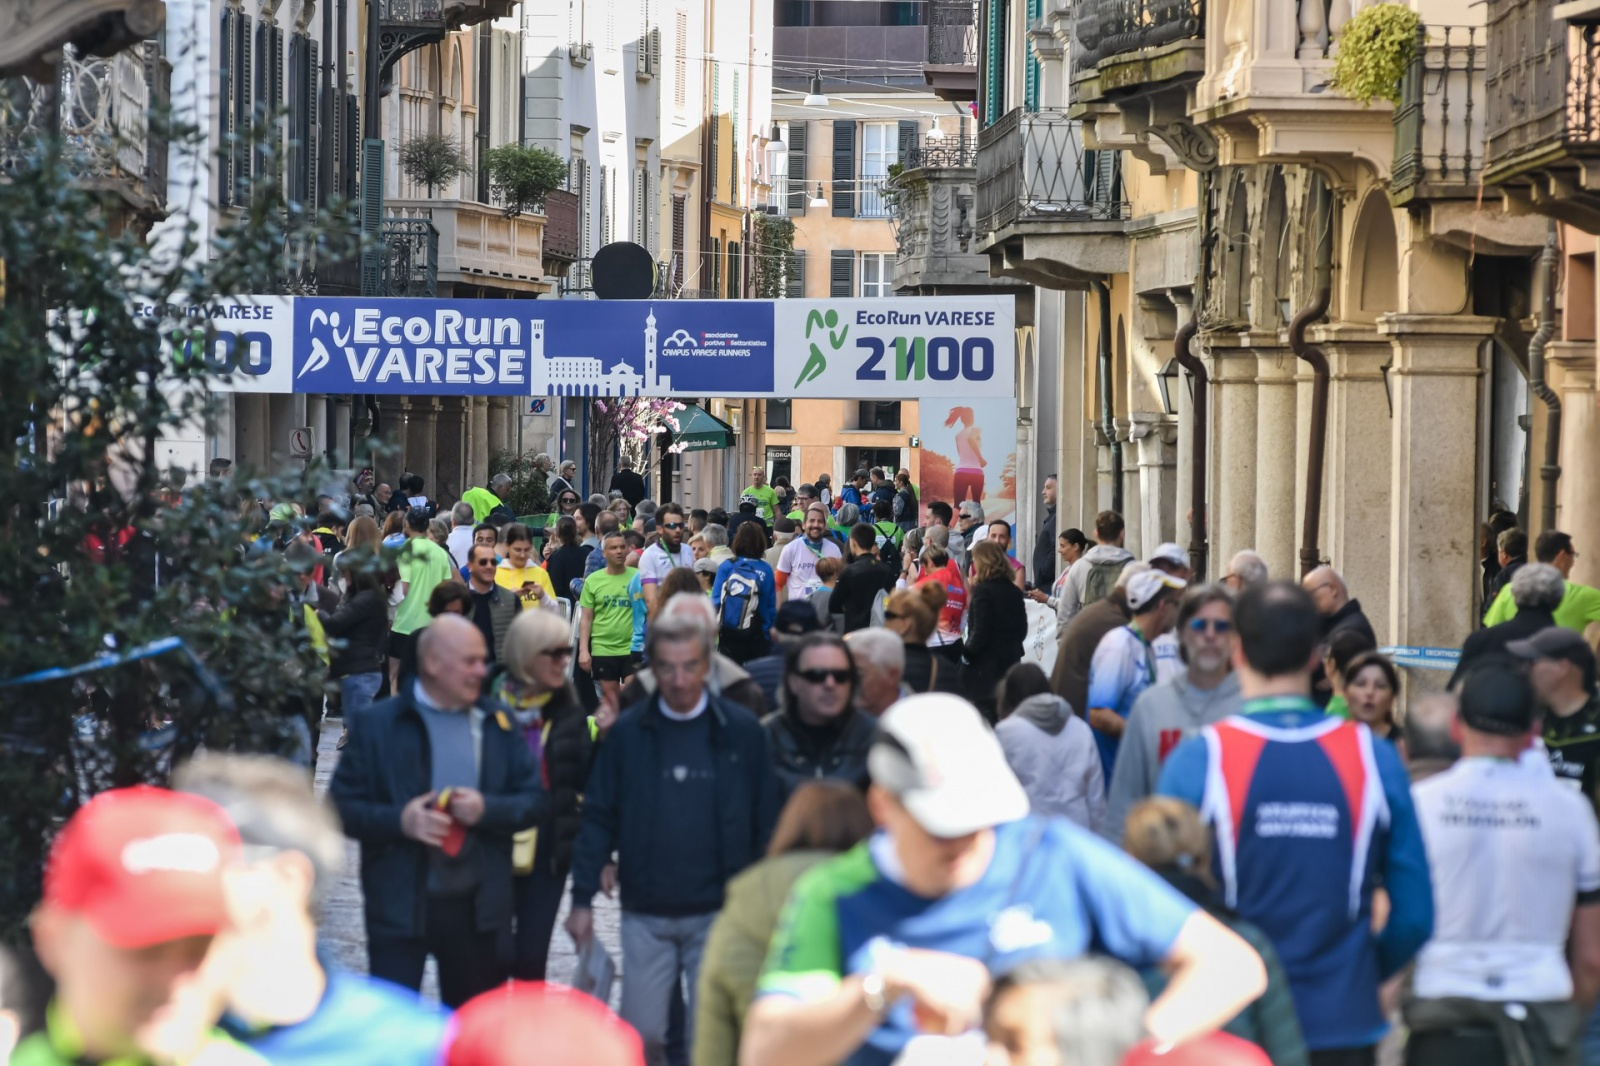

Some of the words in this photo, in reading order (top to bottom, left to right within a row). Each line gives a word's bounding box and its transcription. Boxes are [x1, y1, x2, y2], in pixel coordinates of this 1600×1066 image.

[203, 304, 273, 320] VARESE
[856, 310, 921, 325] EcoRun
[925, 311, 995, 326] VARESE
[353, 308, 522, 346] EcoRun
[718, 349, 750, 357] RUNNERS
[344, 347, 526, 385] VARESE
